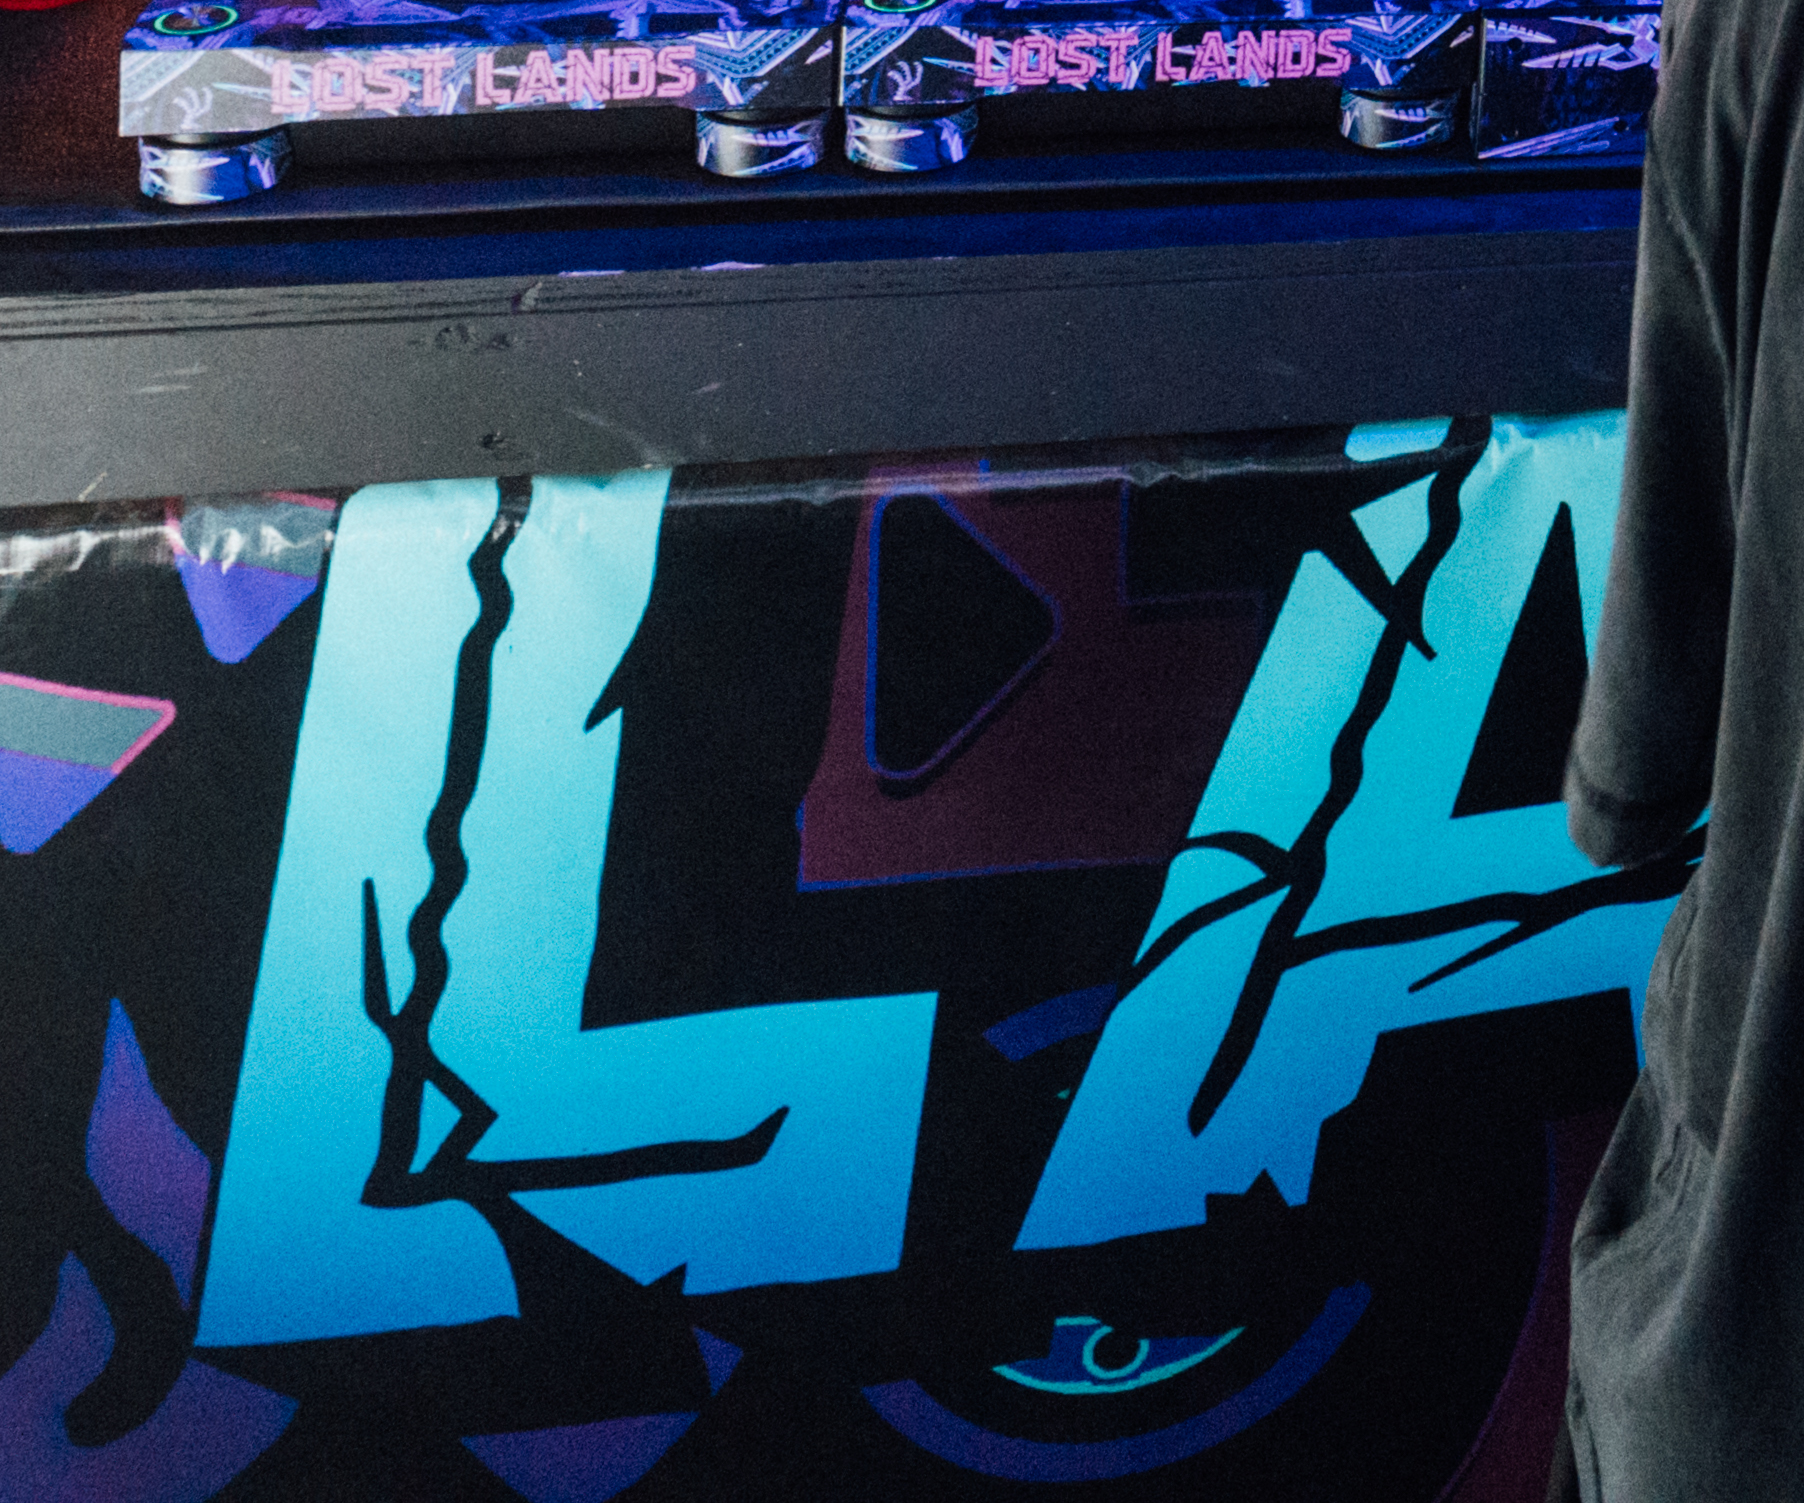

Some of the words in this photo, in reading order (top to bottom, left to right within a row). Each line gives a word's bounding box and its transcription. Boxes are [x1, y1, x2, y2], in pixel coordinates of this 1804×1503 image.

[270, 51, 456, 115] LOST
[475, 44, 697, 107] LANDS
[973, 32, 1139, 88] LOST
[1155, 28, 1353, 83] LANDS
